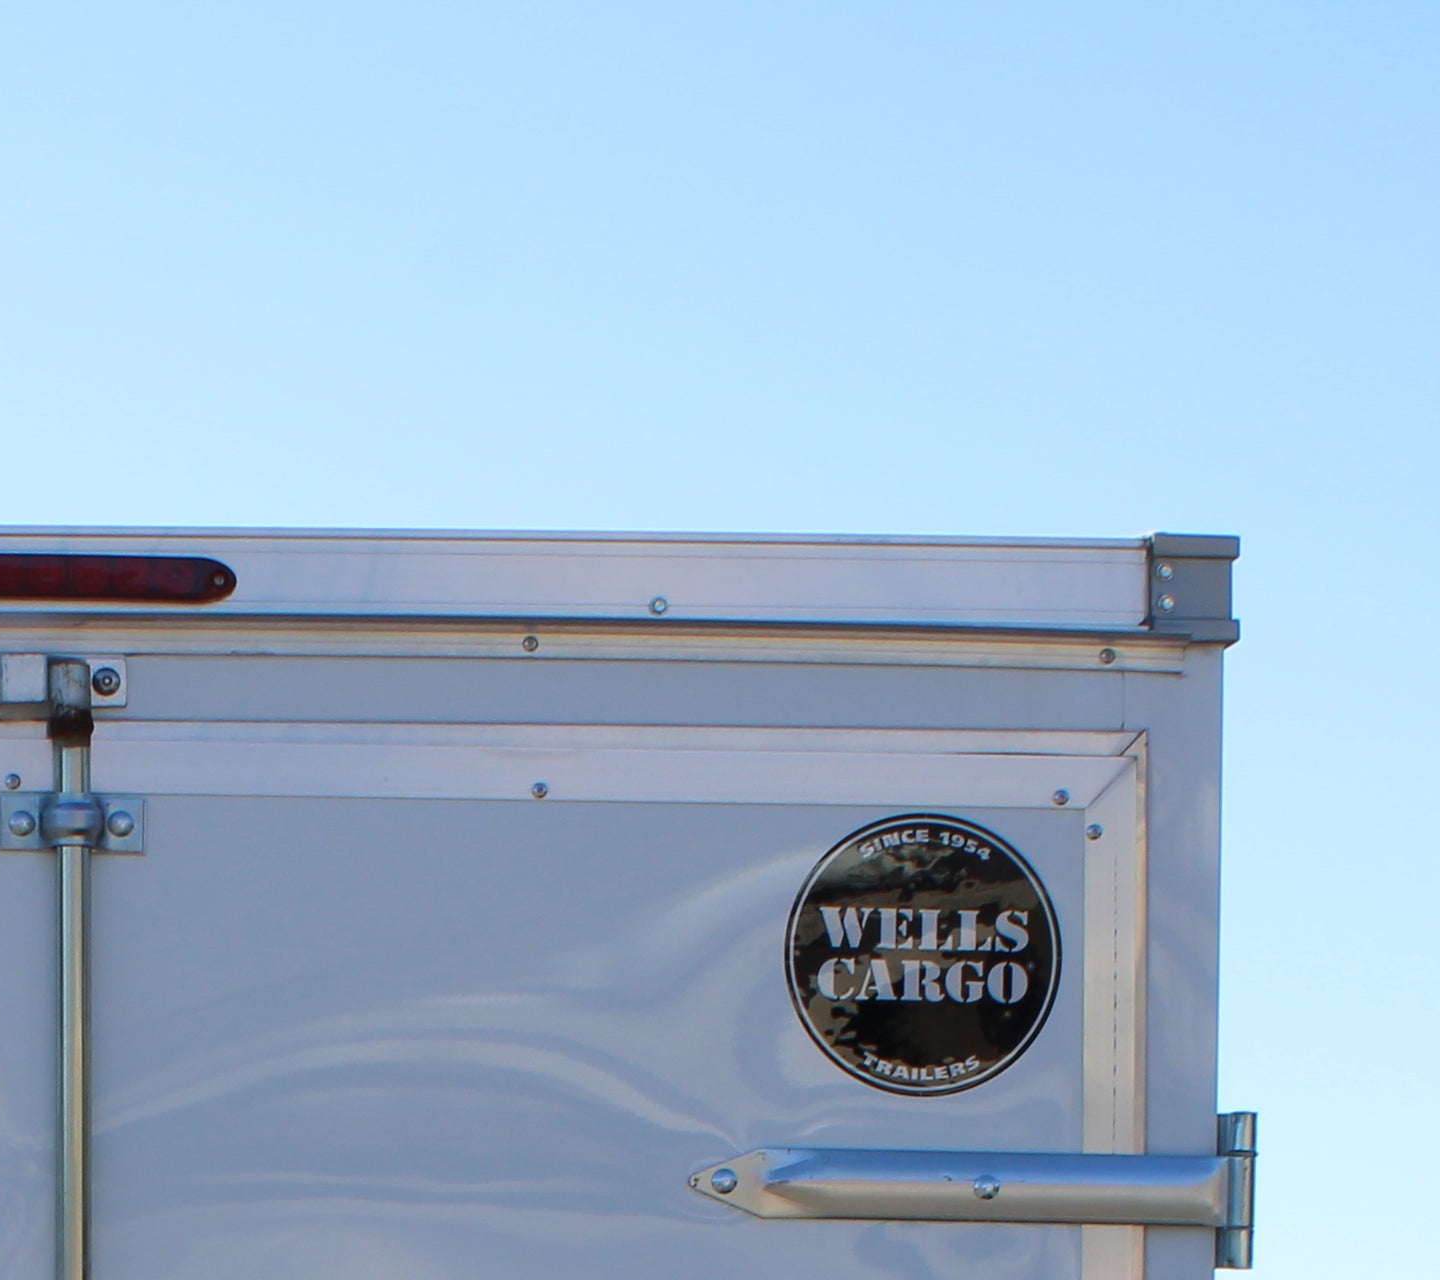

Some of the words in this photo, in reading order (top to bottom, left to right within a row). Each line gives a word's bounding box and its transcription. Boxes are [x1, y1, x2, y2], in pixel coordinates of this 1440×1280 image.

[859, 829, 930, 859] SINCE
[939, 832, 991, 861] 1954
[819, 905, 1030, 953] WELLS
[817, 957, 1029, 1004] CARGO
[862, 1050, 981, 1081] TRAILERS
